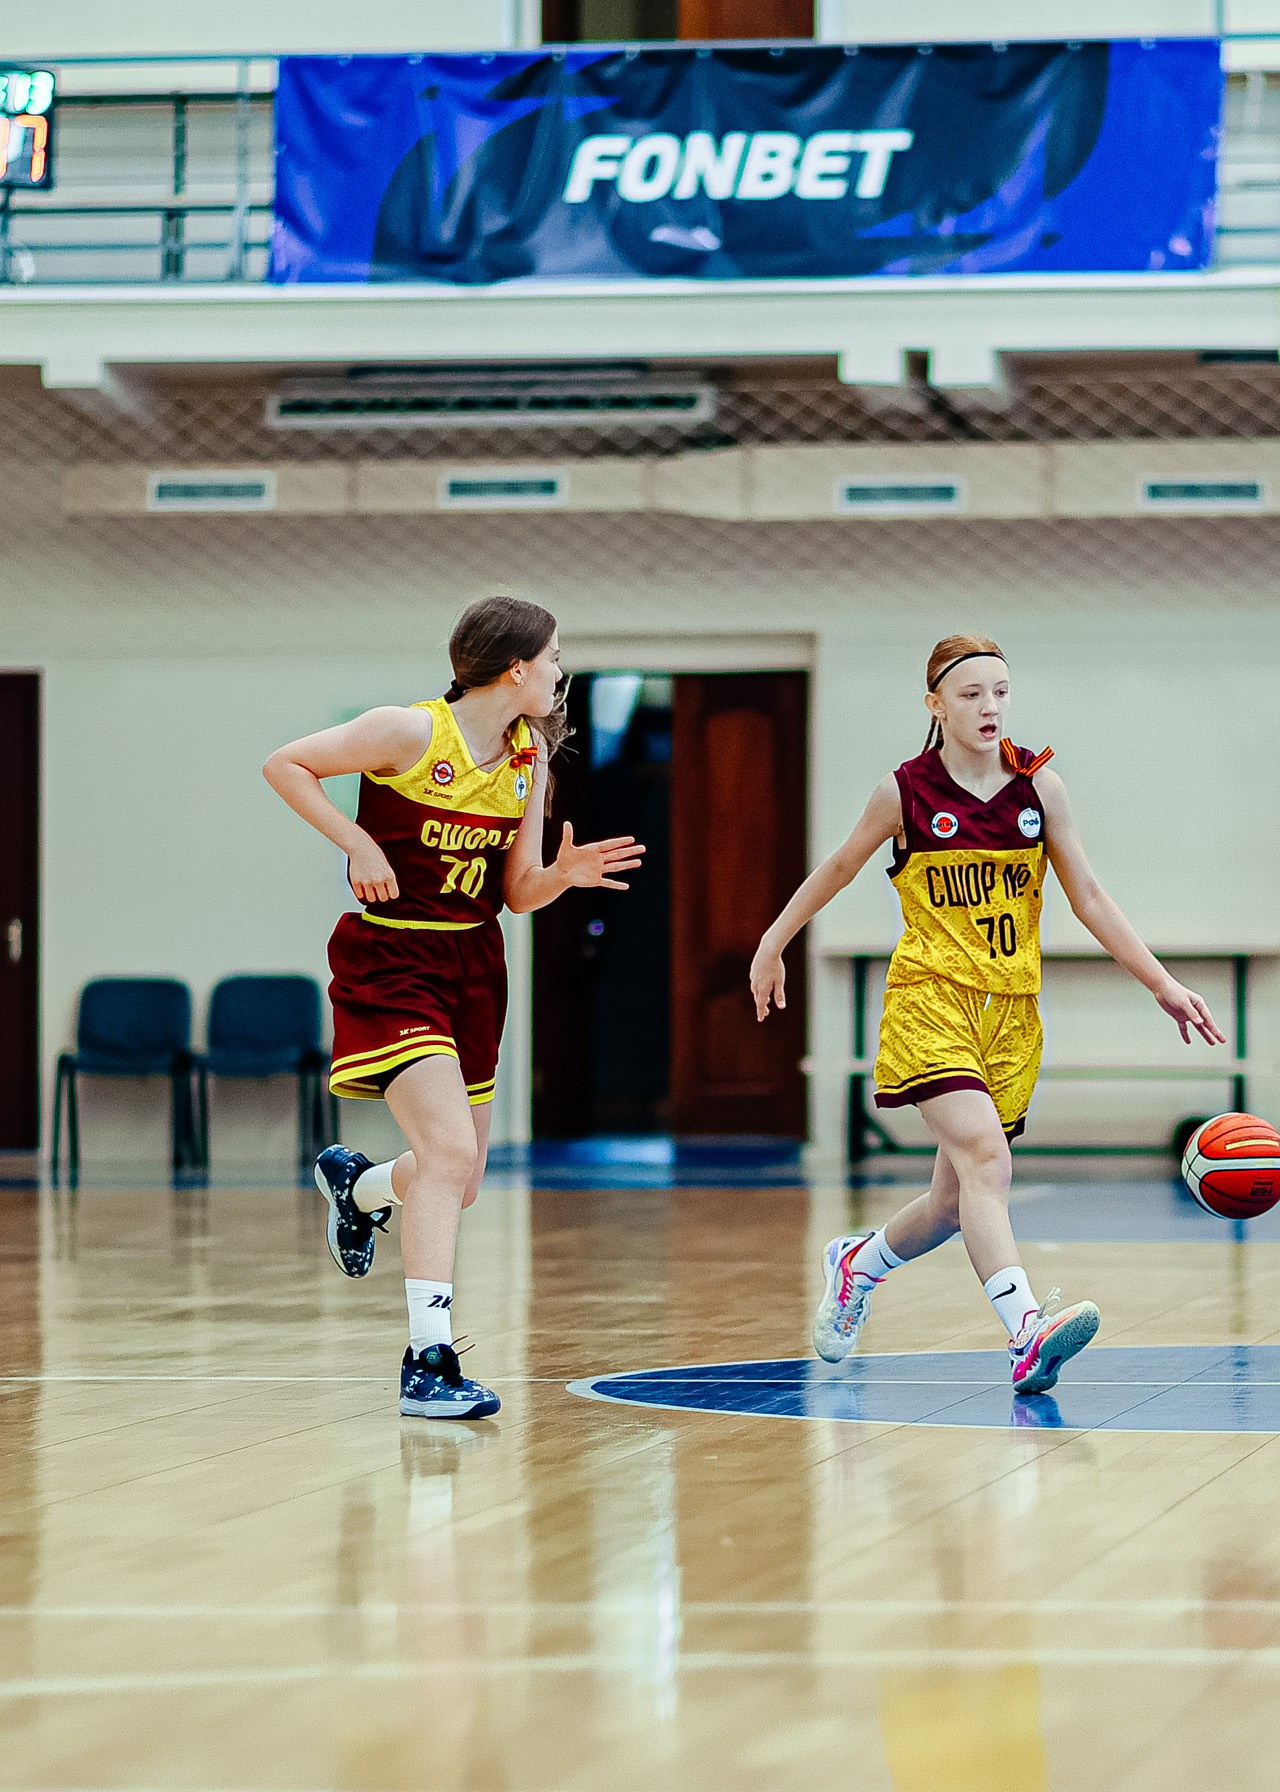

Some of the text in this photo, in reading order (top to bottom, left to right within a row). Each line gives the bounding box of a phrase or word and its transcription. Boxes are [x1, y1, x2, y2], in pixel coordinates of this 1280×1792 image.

[562, 129, 914, 204] FONBET
[440, 854, 487, 899] 70
[926, 861, 996, 908] СШОР
[975, 913, 1017, 960] 70
